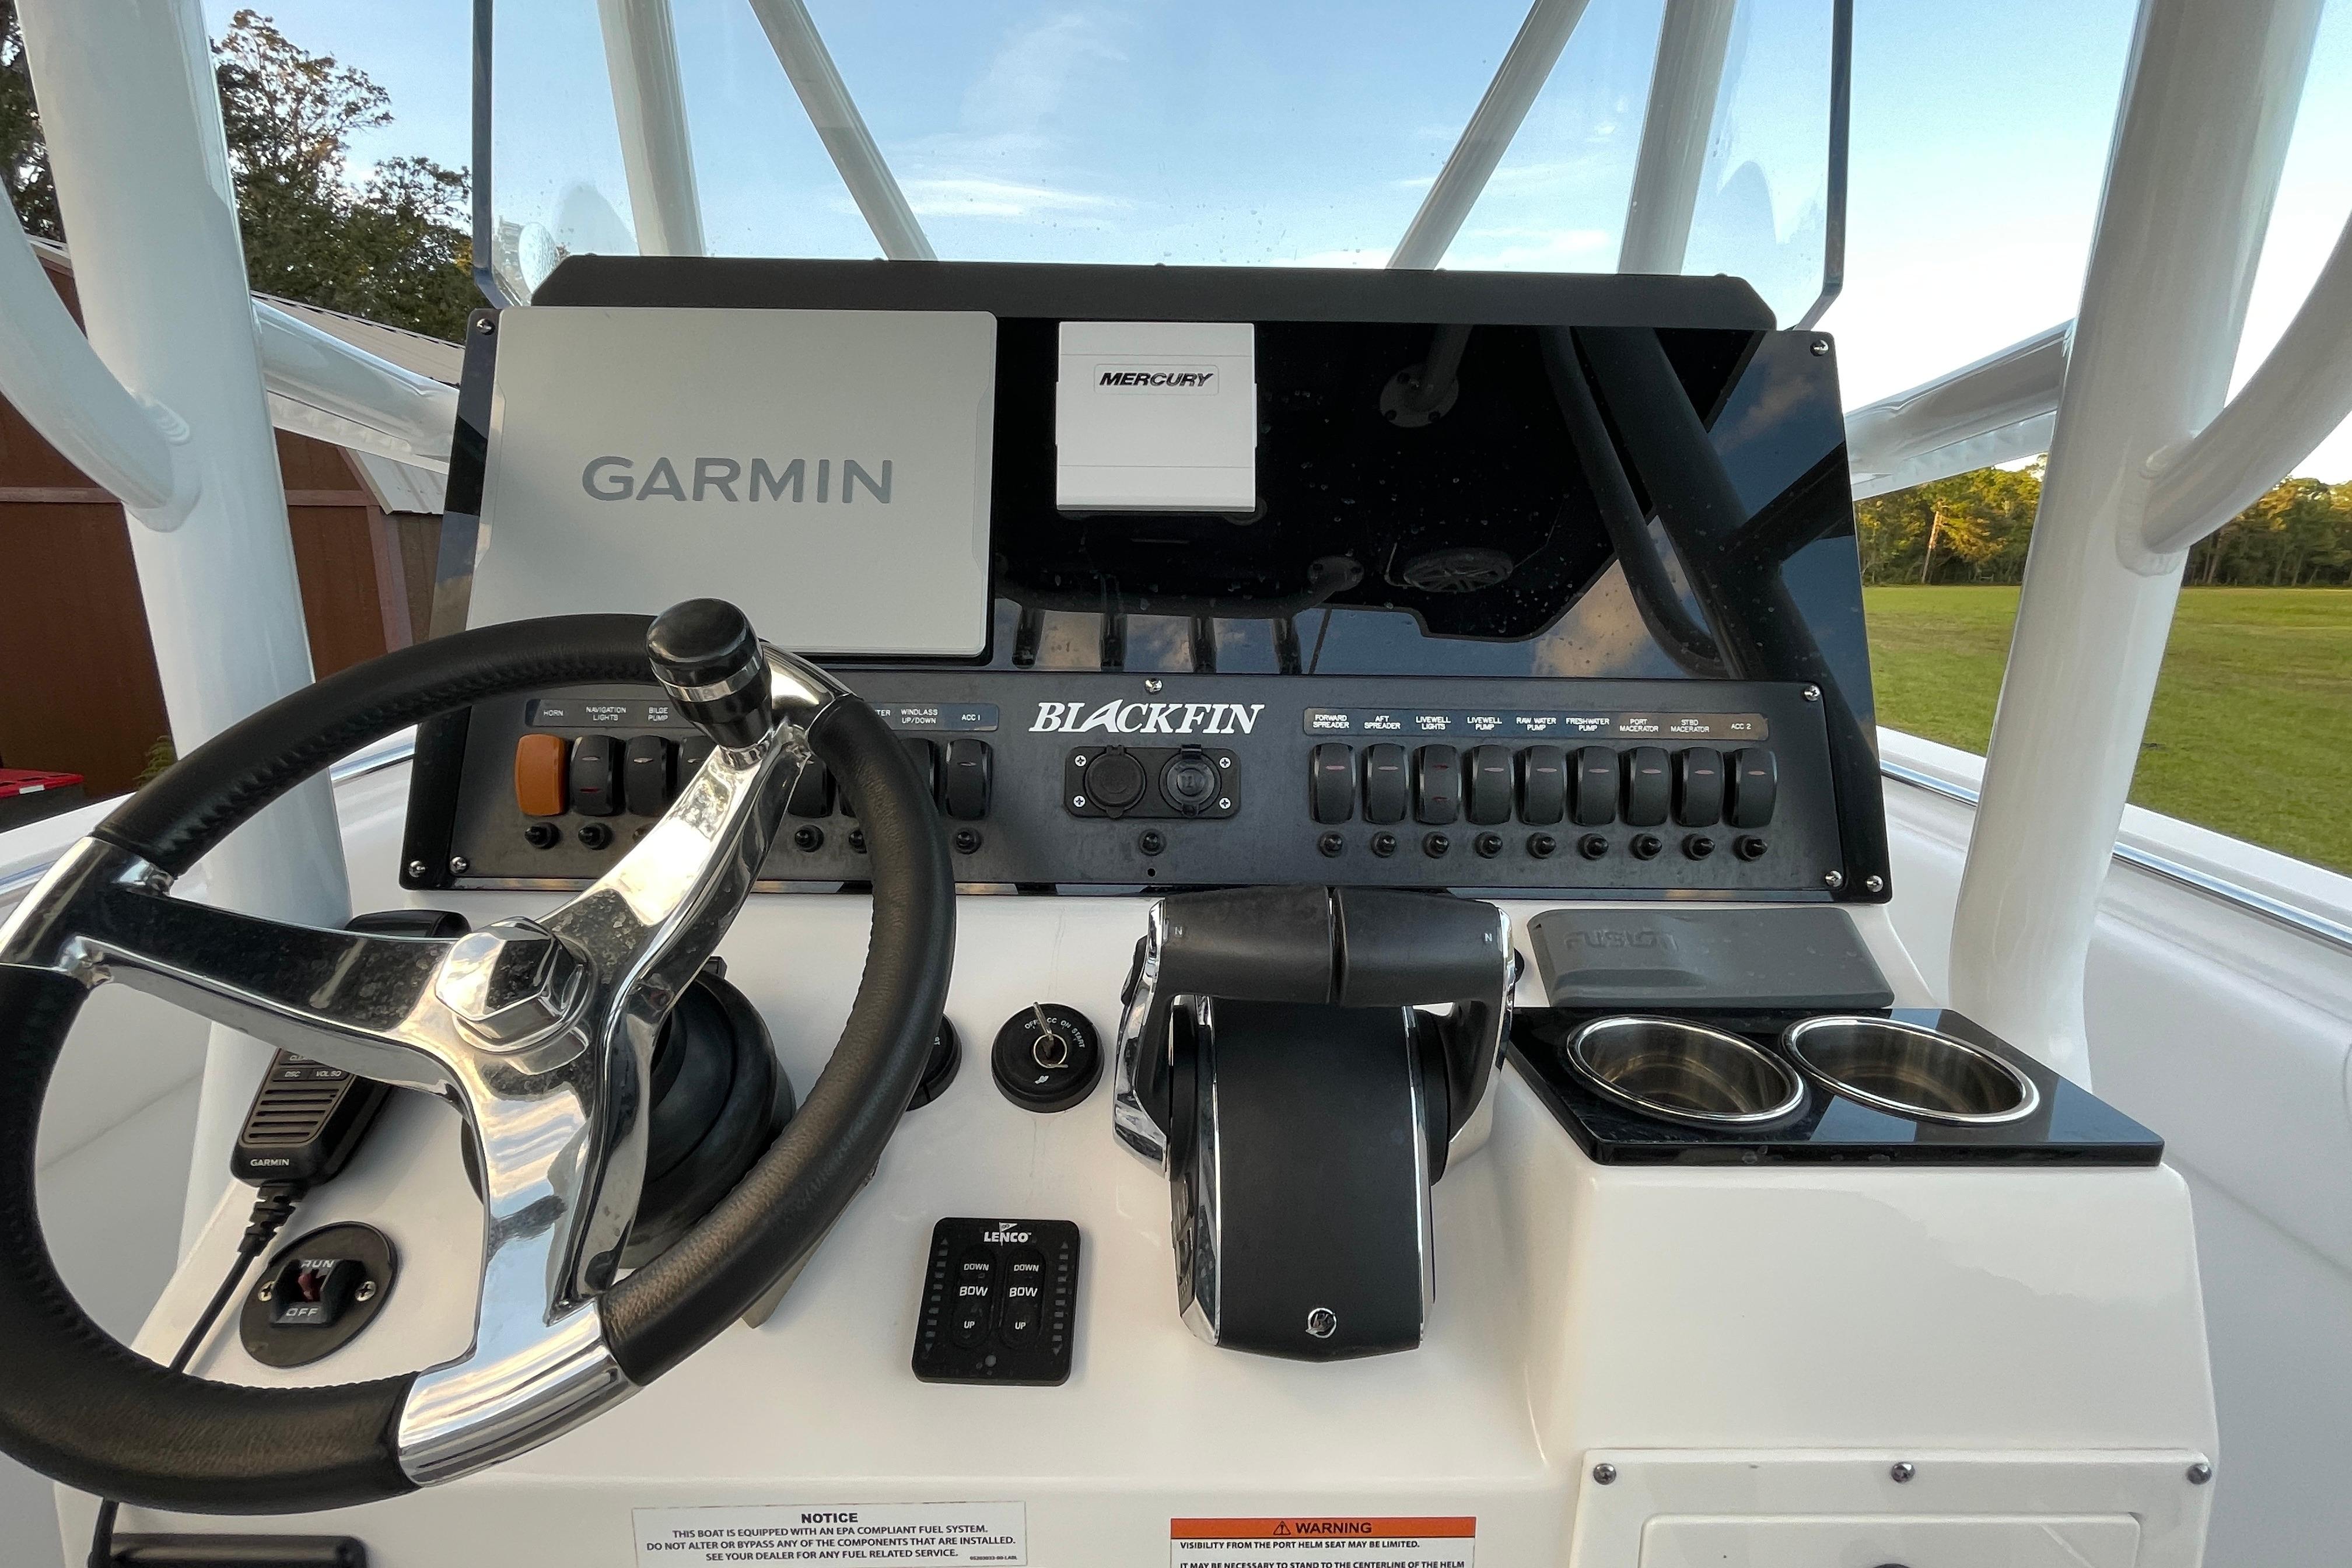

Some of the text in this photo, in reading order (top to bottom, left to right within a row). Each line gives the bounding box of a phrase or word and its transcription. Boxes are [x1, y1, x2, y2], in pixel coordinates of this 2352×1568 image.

[1100, 373, 1214, 387] MERCURY
[582, 456, 892, 504] GARMIN
[1028, 699, 1265, 734] BLACKFIN
[1175, 926, 1182, 935] N
[1484, 933, 1492, 942] N
[1060, 1020, 1072, 1028] ON
[1071, 1028, 1085, 1048] START
[250, 1158, 290, 1167] GARMIN
[300, 1260, 335, 1268] RUN
[964, 1263, 989, 1271] DOWN
[959, 1286, 988, 1296] BOW
[1009, 1287, 1038, 1297] BOW
[285, 1308, 319, 1317] OFF
[964, 1321, 975, 1329] UP
[1014, 1321, 1026, 1329] UP
[801, 1513, 859, 1523] NOTICE
[672, 1530, 695, 1538] THIS
[737, 1528, 788, 1537] EQUIPPED
[857, 1526, 916, 1534] COMPLIANT
[946, 1525, 988, 1533] SYSTEM.
[1295, 1522, 1373, 1534] WARNING
[737, 1540, 774, 1548] BYPASS
[837, 1538, 908, 1546] COMPONENTS
[960, 1536, 1016, 1545] INSTALLED.
[755, 1552, 794, 1560] DEALER
[869, 1549, 912, 1558] RELATED
[915, 1549, 958, 1557] SERVICE.
